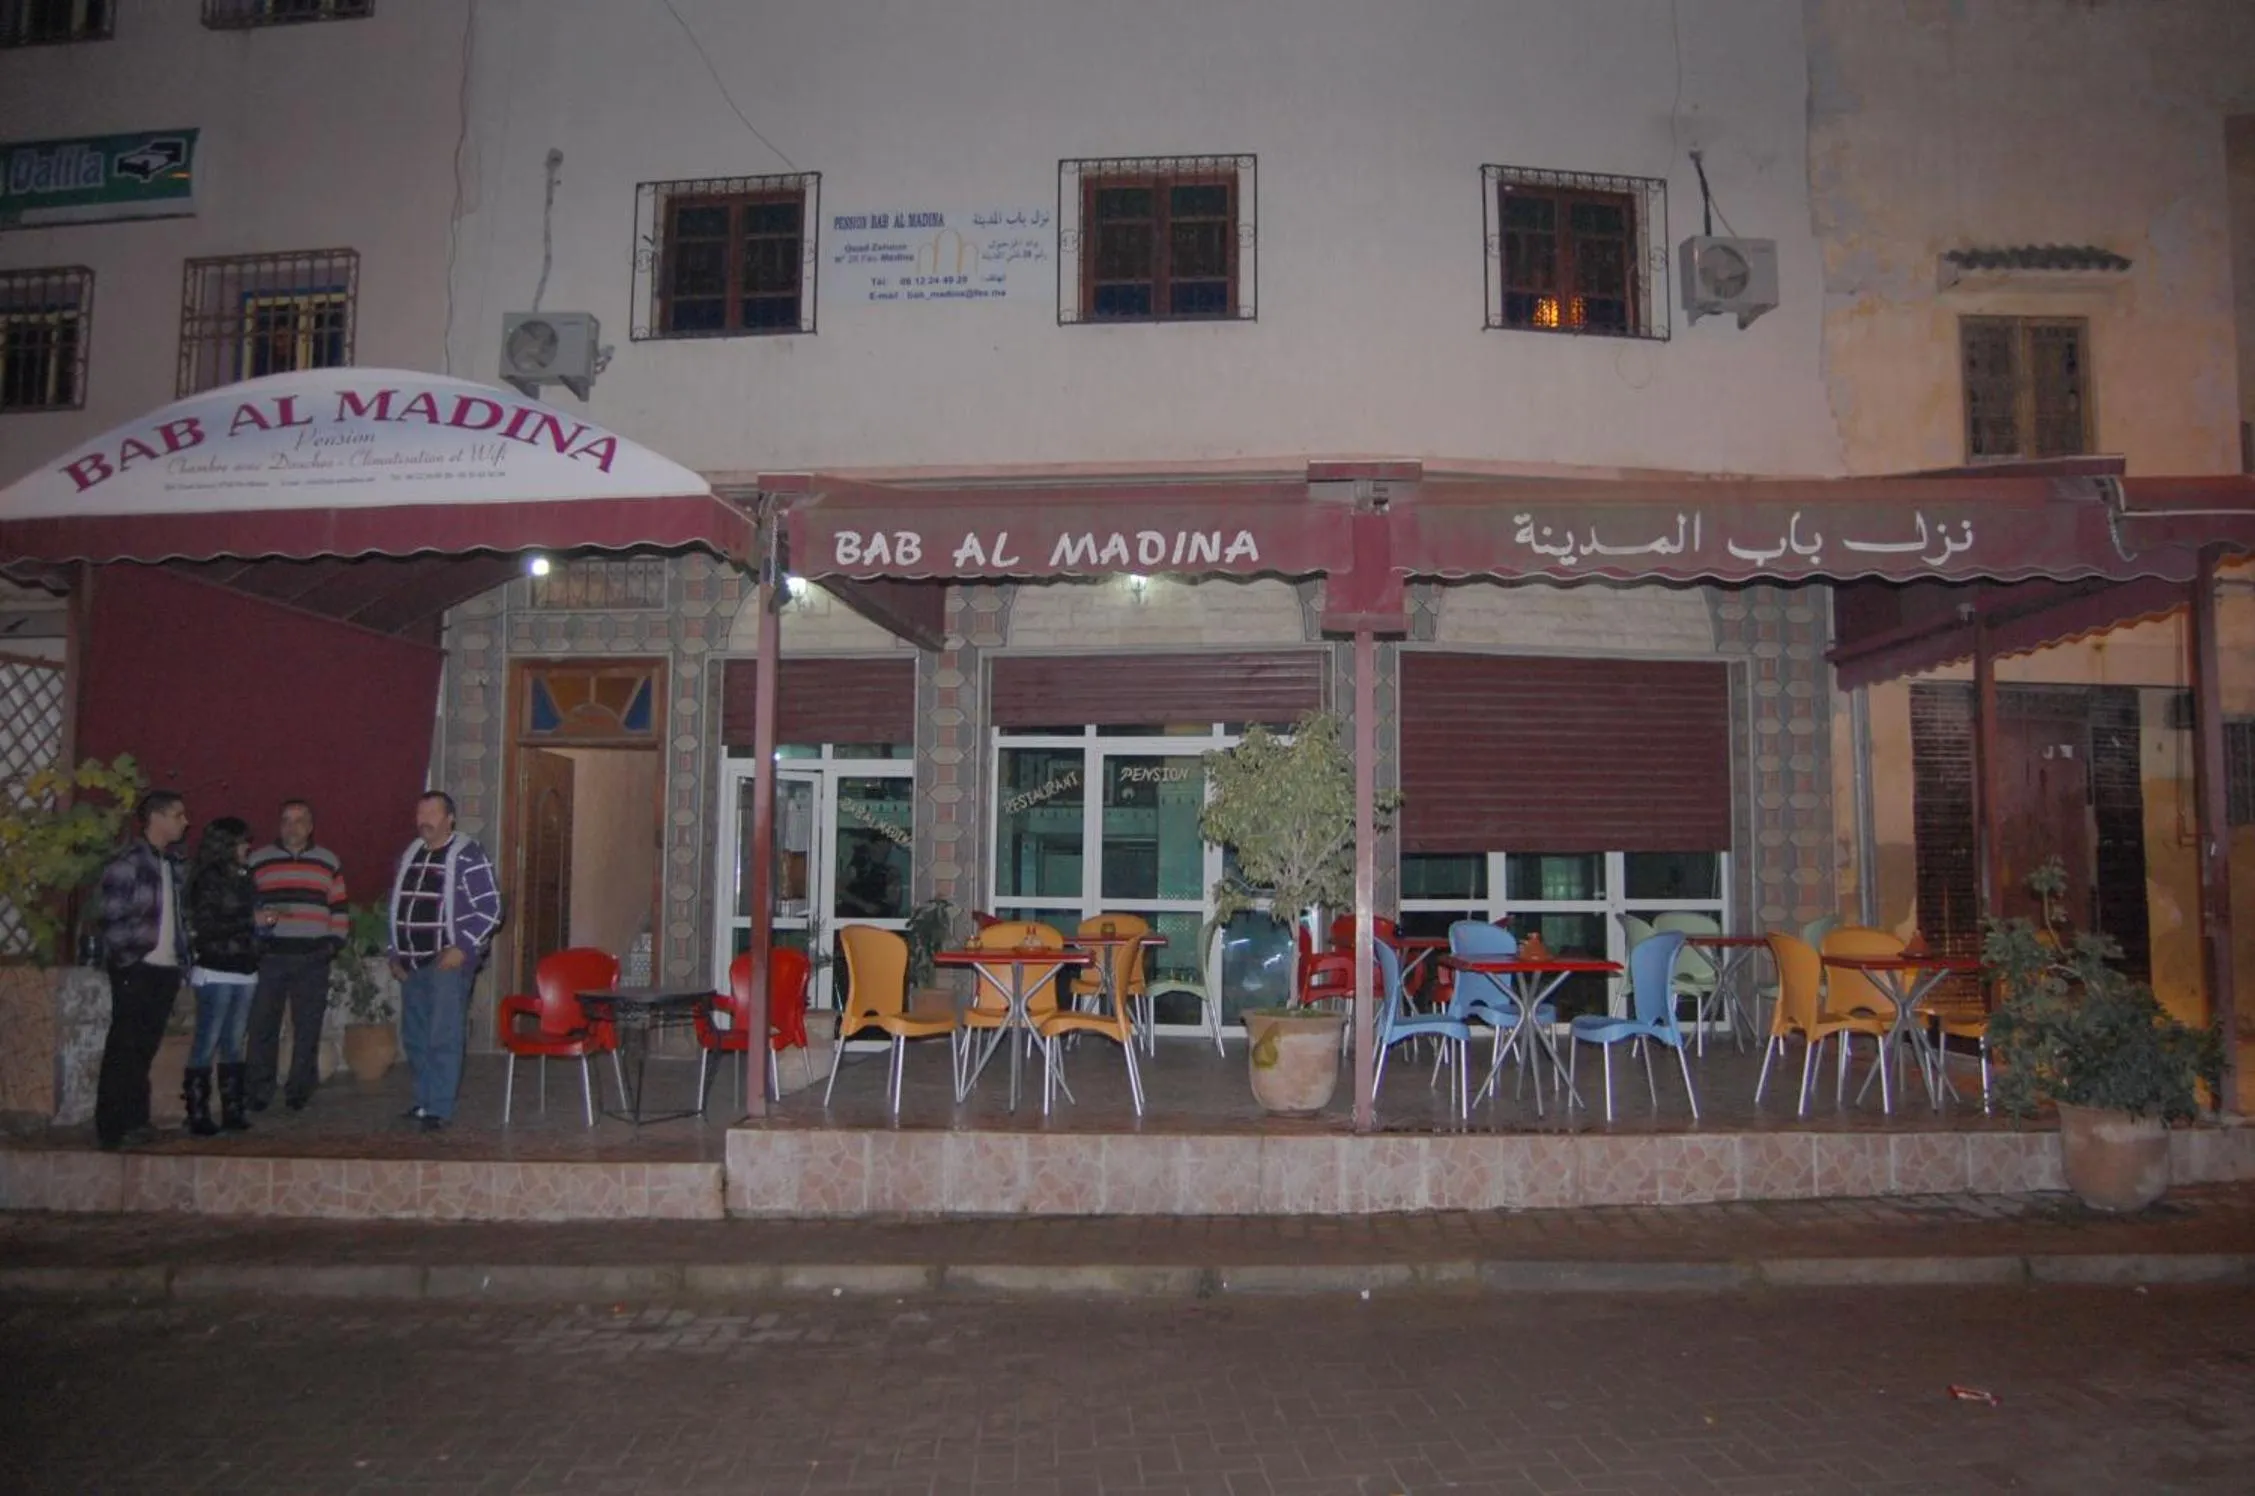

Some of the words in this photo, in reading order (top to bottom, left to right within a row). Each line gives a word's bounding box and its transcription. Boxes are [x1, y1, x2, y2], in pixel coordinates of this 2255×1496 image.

[834, 215, 867, 230] PENSION
[870, 212, 889, 229] BAB
[894, 212, 904, 229] AL
[907, 211, 945, 228] MADINA
[59, 416, 206, 492] BAB
[227, 395, 314, 437] AL
[335, 390, 621, 473] MADINA
[294, 428, 377, 452] Pension
[834, 530, 921, 565] BAB
[952, 531, 1020, 568] AL
[1049, 529, 1260, 567] MADINA
[1513, 510, 1701, 566] المدينة
[1728, 509, 1823, 567] باب
[1842, 510, 1974, 566] نزل
[1002, 770, 1080, 816] RESTAURANT
[1119, 766, 1190, 783] PENSION
